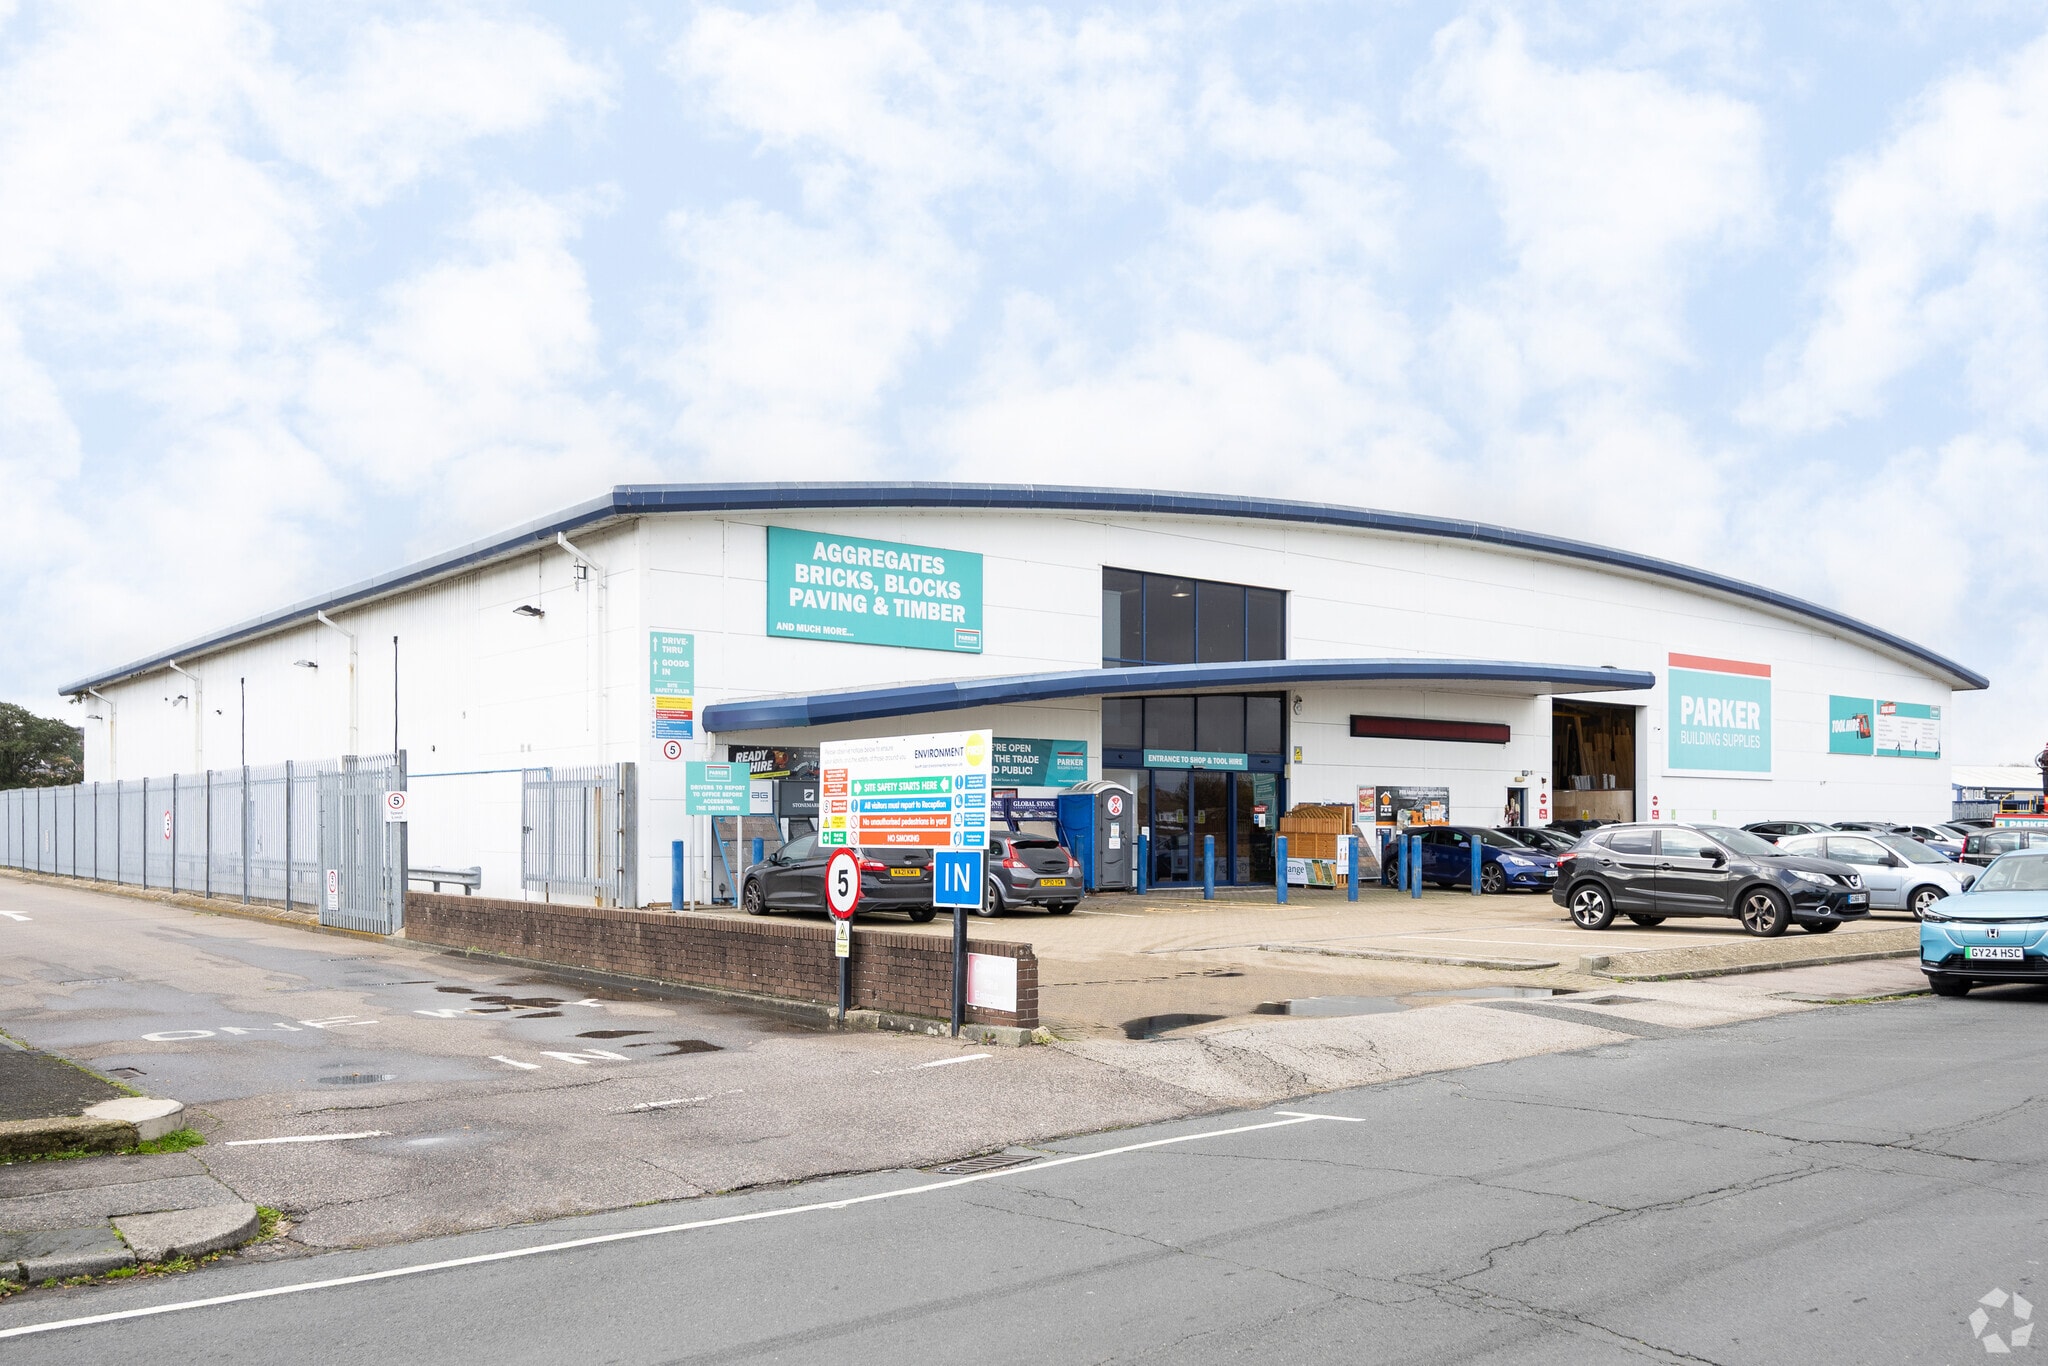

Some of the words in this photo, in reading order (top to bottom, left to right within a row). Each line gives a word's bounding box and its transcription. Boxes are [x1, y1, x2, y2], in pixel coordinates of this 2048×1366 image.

[813, 541, 945, 575] AGGREGATES
[795, 563, 879, 594] BRICKS,
[884, 574, 961, 600] BLOCKS
[789, 587, 867, 613] PAVING
[873, 596, 889, 616] &
[893, 598, 966, 623] TIMBER
[776, 622, 794, 632] AND
[796, 623, 821, 634] MUCH
[823, 625, 855, 637] MORE...
[662, 646, 683, 654] THRU
[661, 659, 690, 667] GOODS
[1681, 695, 1760, 730] PARKER
[1832, 719, 1845, 733] TOOL
[1681, 730, 1721, 746] BUILDING
[1722, 733, 1760, 749] SUPPLIES
[670, 745, 676, 755] 5
[915, 747, 964, 759] ENVIRONMENT
[1009, 744, 1031, 753] OPEN
[735, 750, 768, 763] READY
[994, 755, 1010, 763] THE
[1012, 755, 1039, 764] TRADE
[1148, 754, 1180, 763] ENTRANCE
[750, 760, 773, 772] HIRE
[1001, 766, 1033, 775] PUBLIC!
[864, 783, 876, 792] SITE
[877, 782, 897, 792] SAFETY
[899, 781, 920, 791] STARTS
[922, 781, 937, 790] HERE
[393, 796, 400, 805] 5
[872, 801, 887, 809] visitors
[888, 801, 900, 809] must
[900, 801, 915, 810] report
[922, 800, 946, 810] Reception
[871, 817, 900, 826] unauthorised
[901, 817, 929, 827] pedestrians
[930, 817, 935, 825] in
[936, 817, 948, 827] yard
[887, 834, 895, 842] NO
[896, 834, 920, 842] SMOKING
[944, 862, 970, 892] IN
[838, 869, 849, 897] 5
[1971, 948, 1997, 957] GY24
[2000, 949, 2020, 958] HSC
[141, 1014, 379, 1042] ONE
